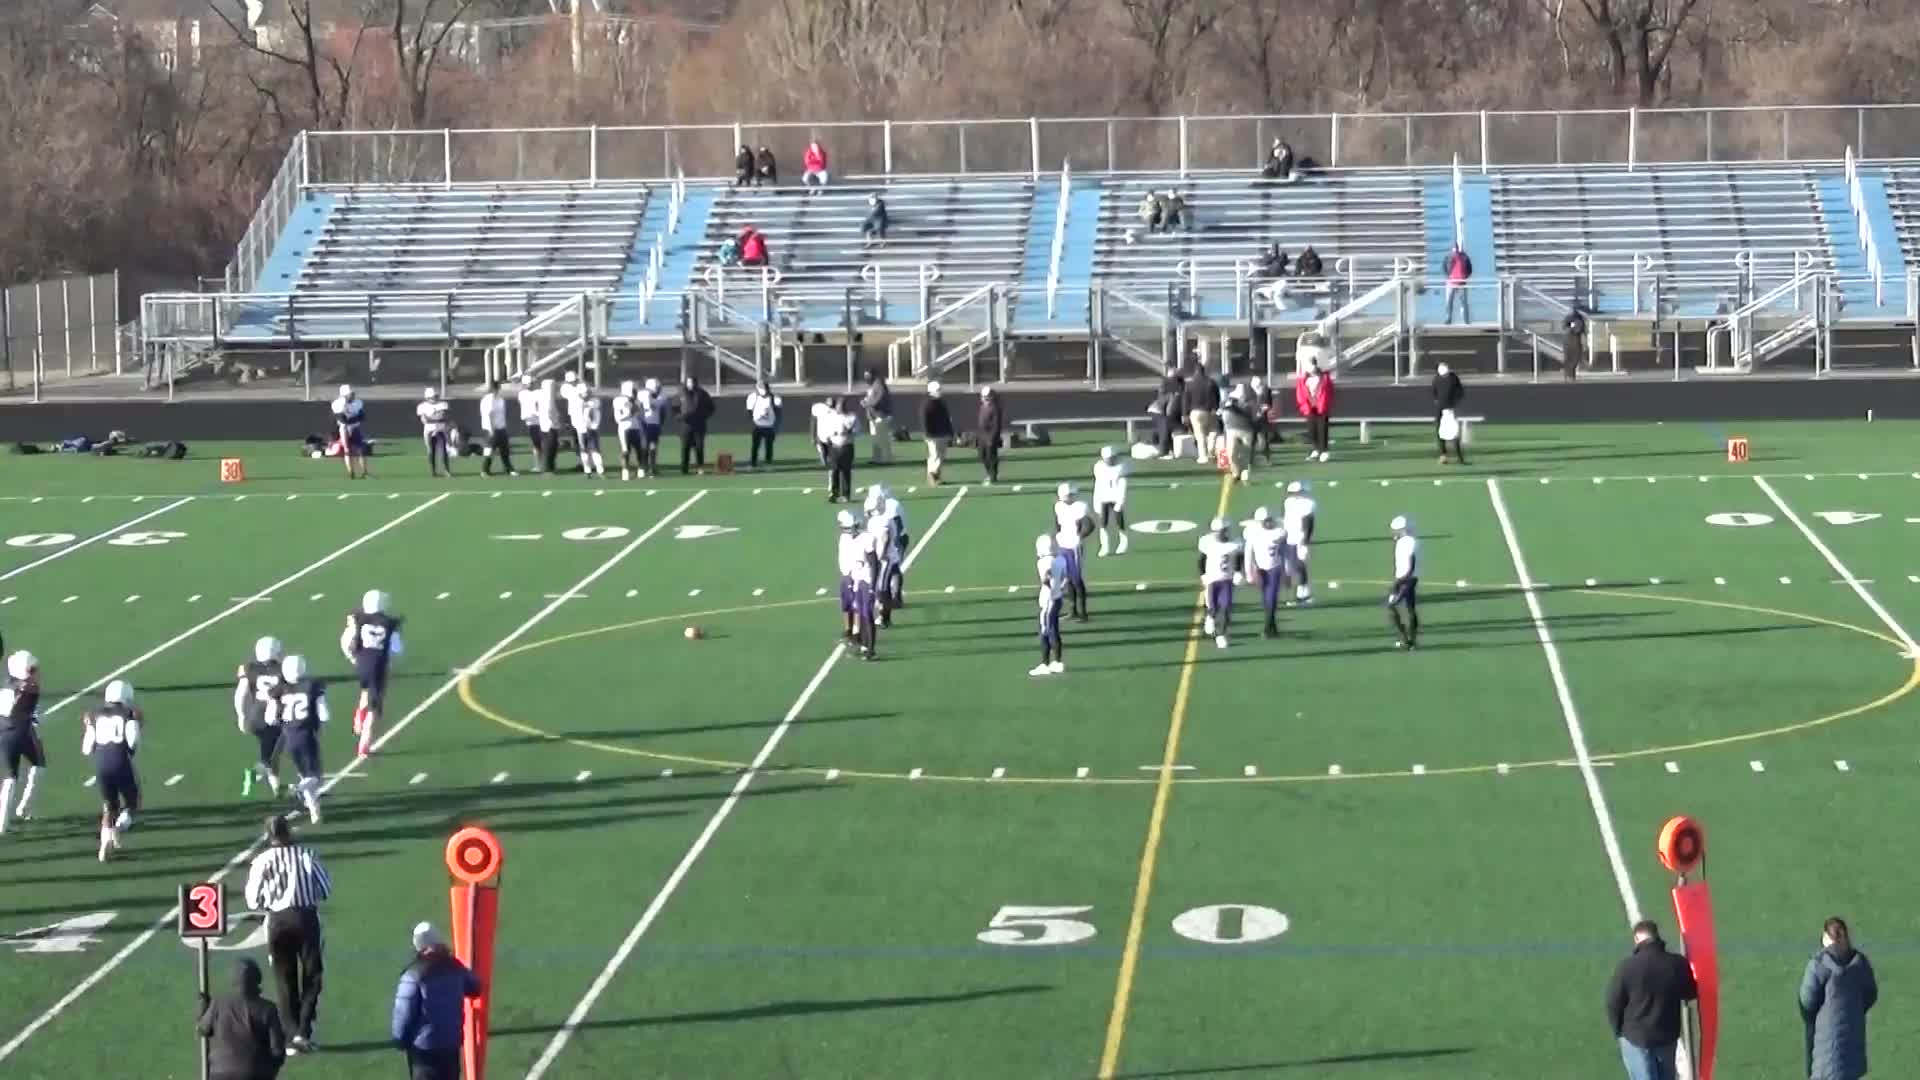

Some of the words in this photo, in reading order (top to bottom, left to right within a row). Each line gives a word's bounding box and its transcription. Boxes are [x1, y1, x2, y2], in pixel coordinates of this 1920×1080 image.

[1730, 441, 1747, 461] 40
[222, 461, 241, 480] 30
[282, 693, 308, 721] 72
[188, 885, 218, 929] 3
[976, 903, 1289, 945] 50
